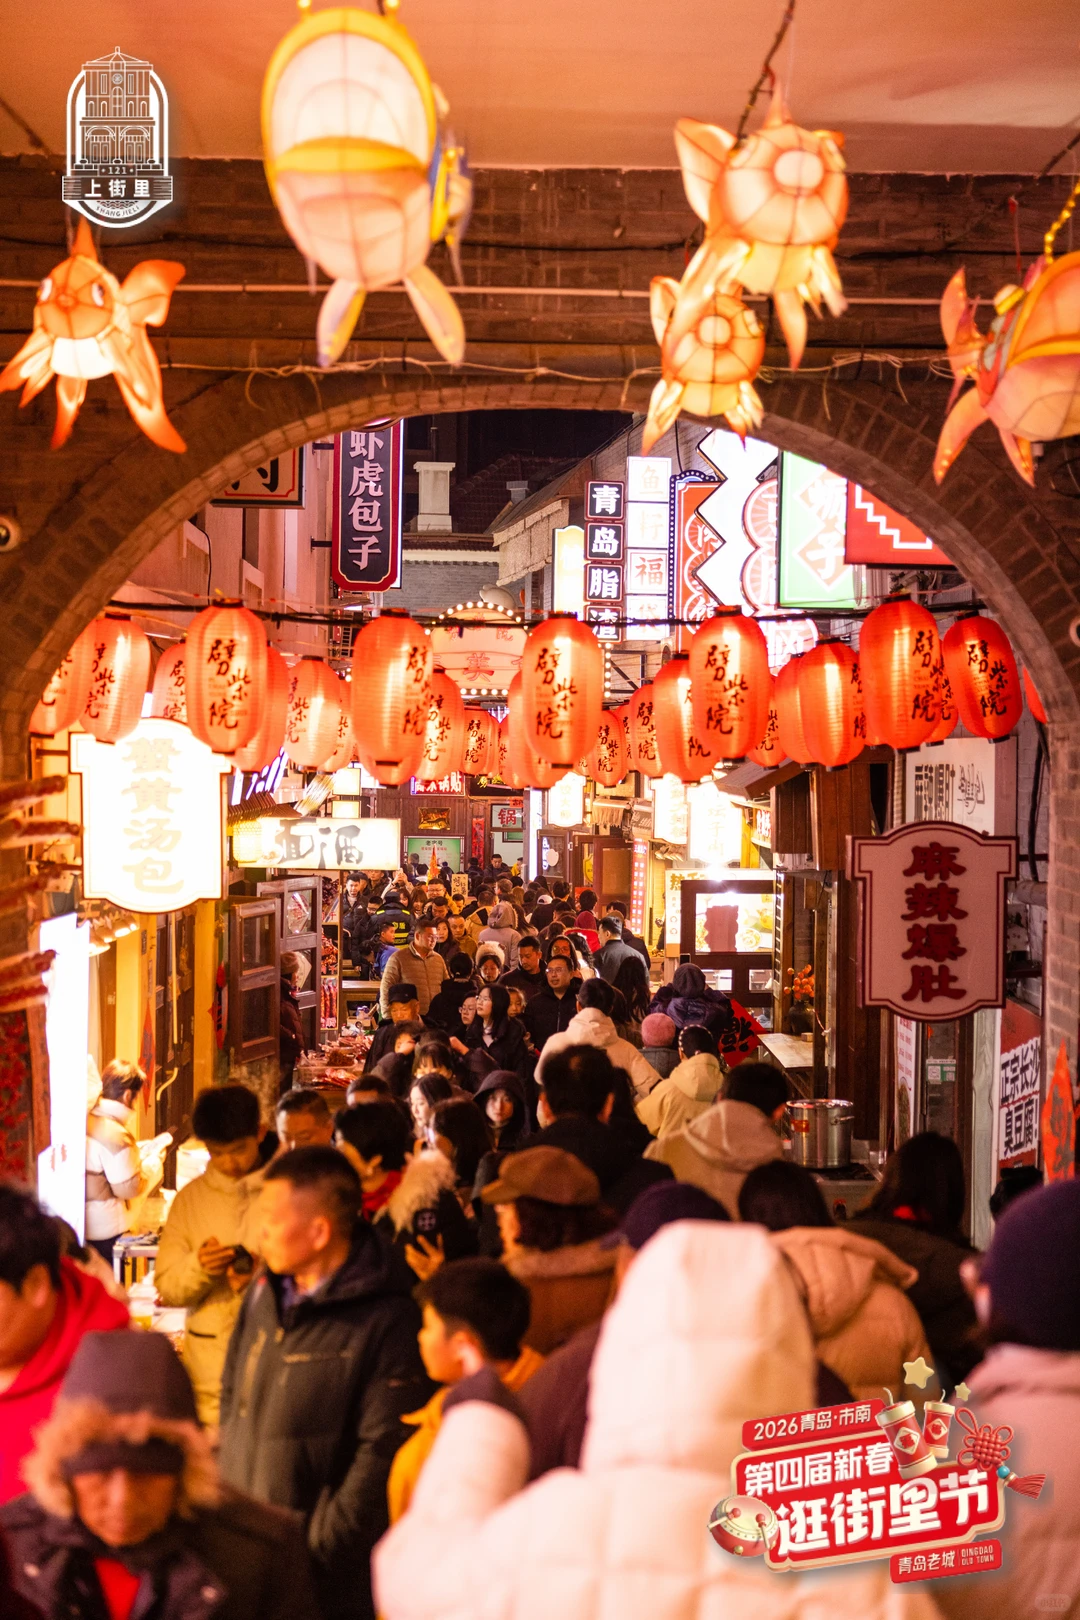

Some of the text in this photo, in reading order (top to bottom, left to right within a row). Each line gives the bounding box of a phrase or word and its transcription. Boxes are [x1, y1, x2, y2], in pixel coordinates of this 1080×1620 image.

[348, 431, 385, 571] 虾虎包子
[588, 485, 621, 641] 青岛脂渣
[207, 640, 251, 729] 劈柴院
[535, 648, 578, 739] 劈柴院
[705, 644, 748, 735] 劈柴院
[967, 640, 1009, 717] 劈柴院
[120, 737, 184, 894] 蟹黄汤包
[901, 842, 969, 1003] 麻辣爆肚
[1001, 1040, 1040, 1105] 正宗长沙
